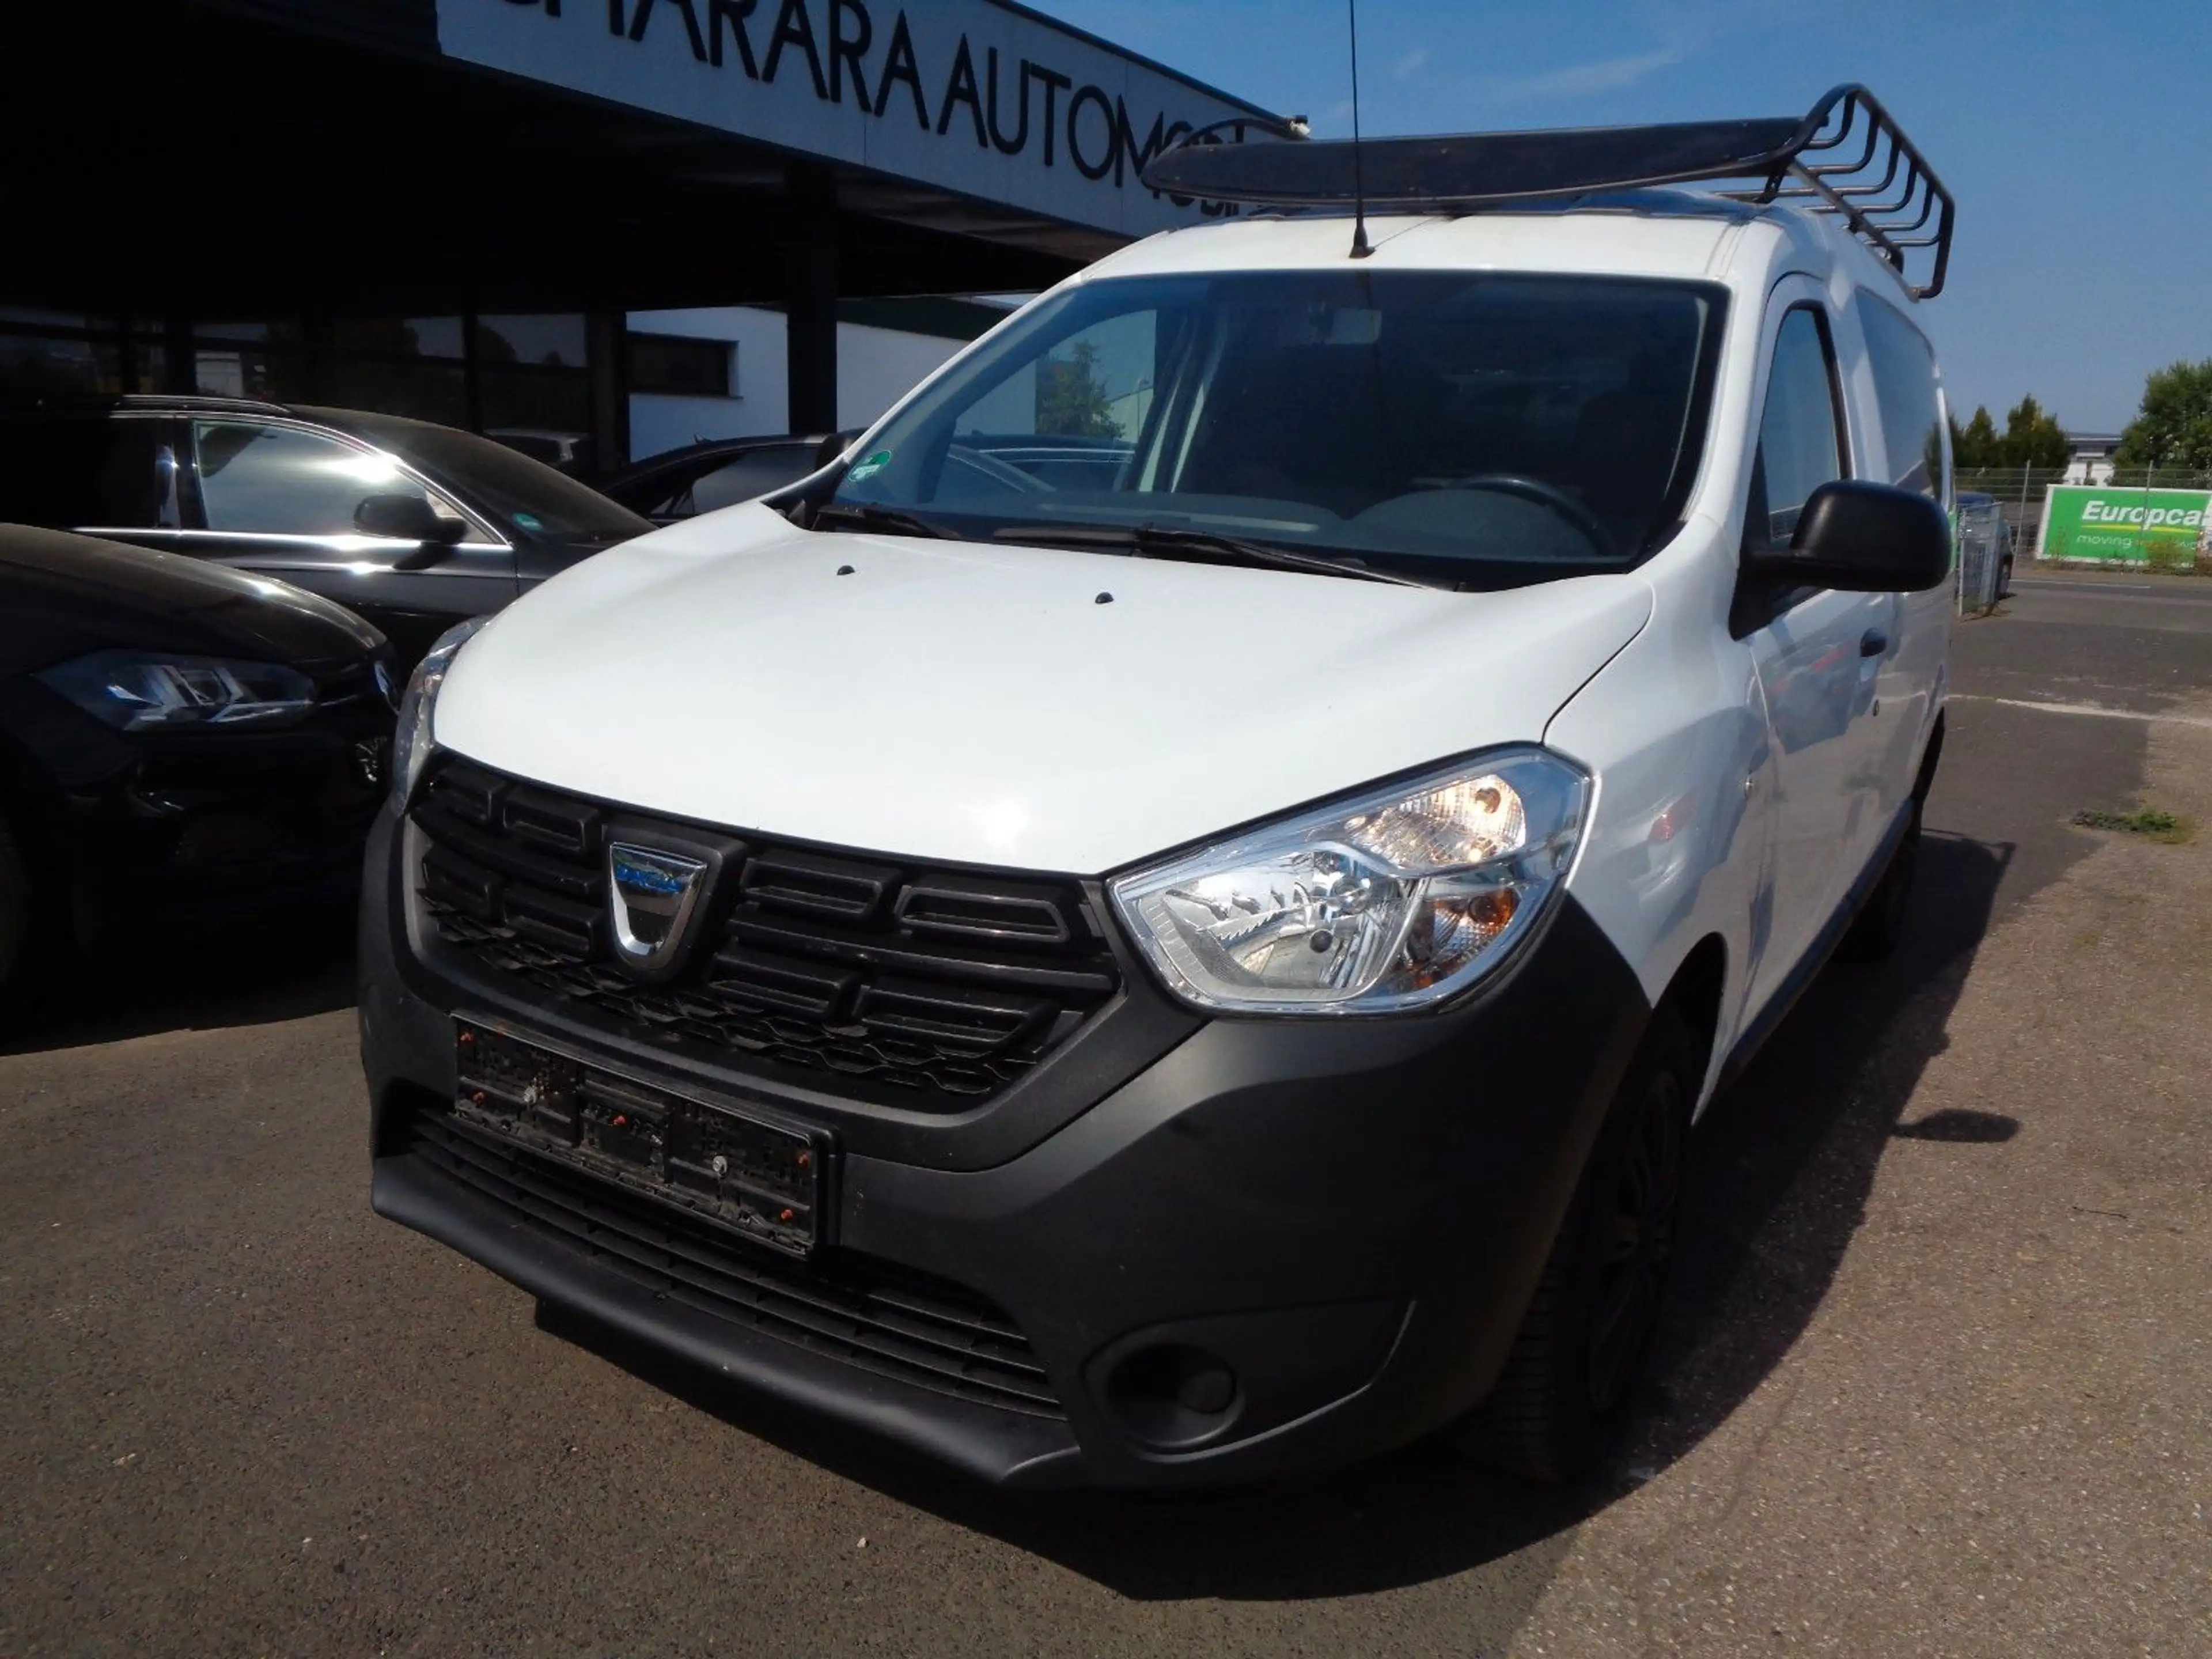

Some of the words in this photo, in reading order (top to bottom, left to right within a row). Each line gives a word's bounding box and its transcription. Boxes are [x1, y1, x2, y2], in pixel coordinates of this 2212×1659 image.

[505, 0, 930, 131] RARA
[2081, 500, 2210, 531] Europca
[2077, 535, 2132, 548] moving
